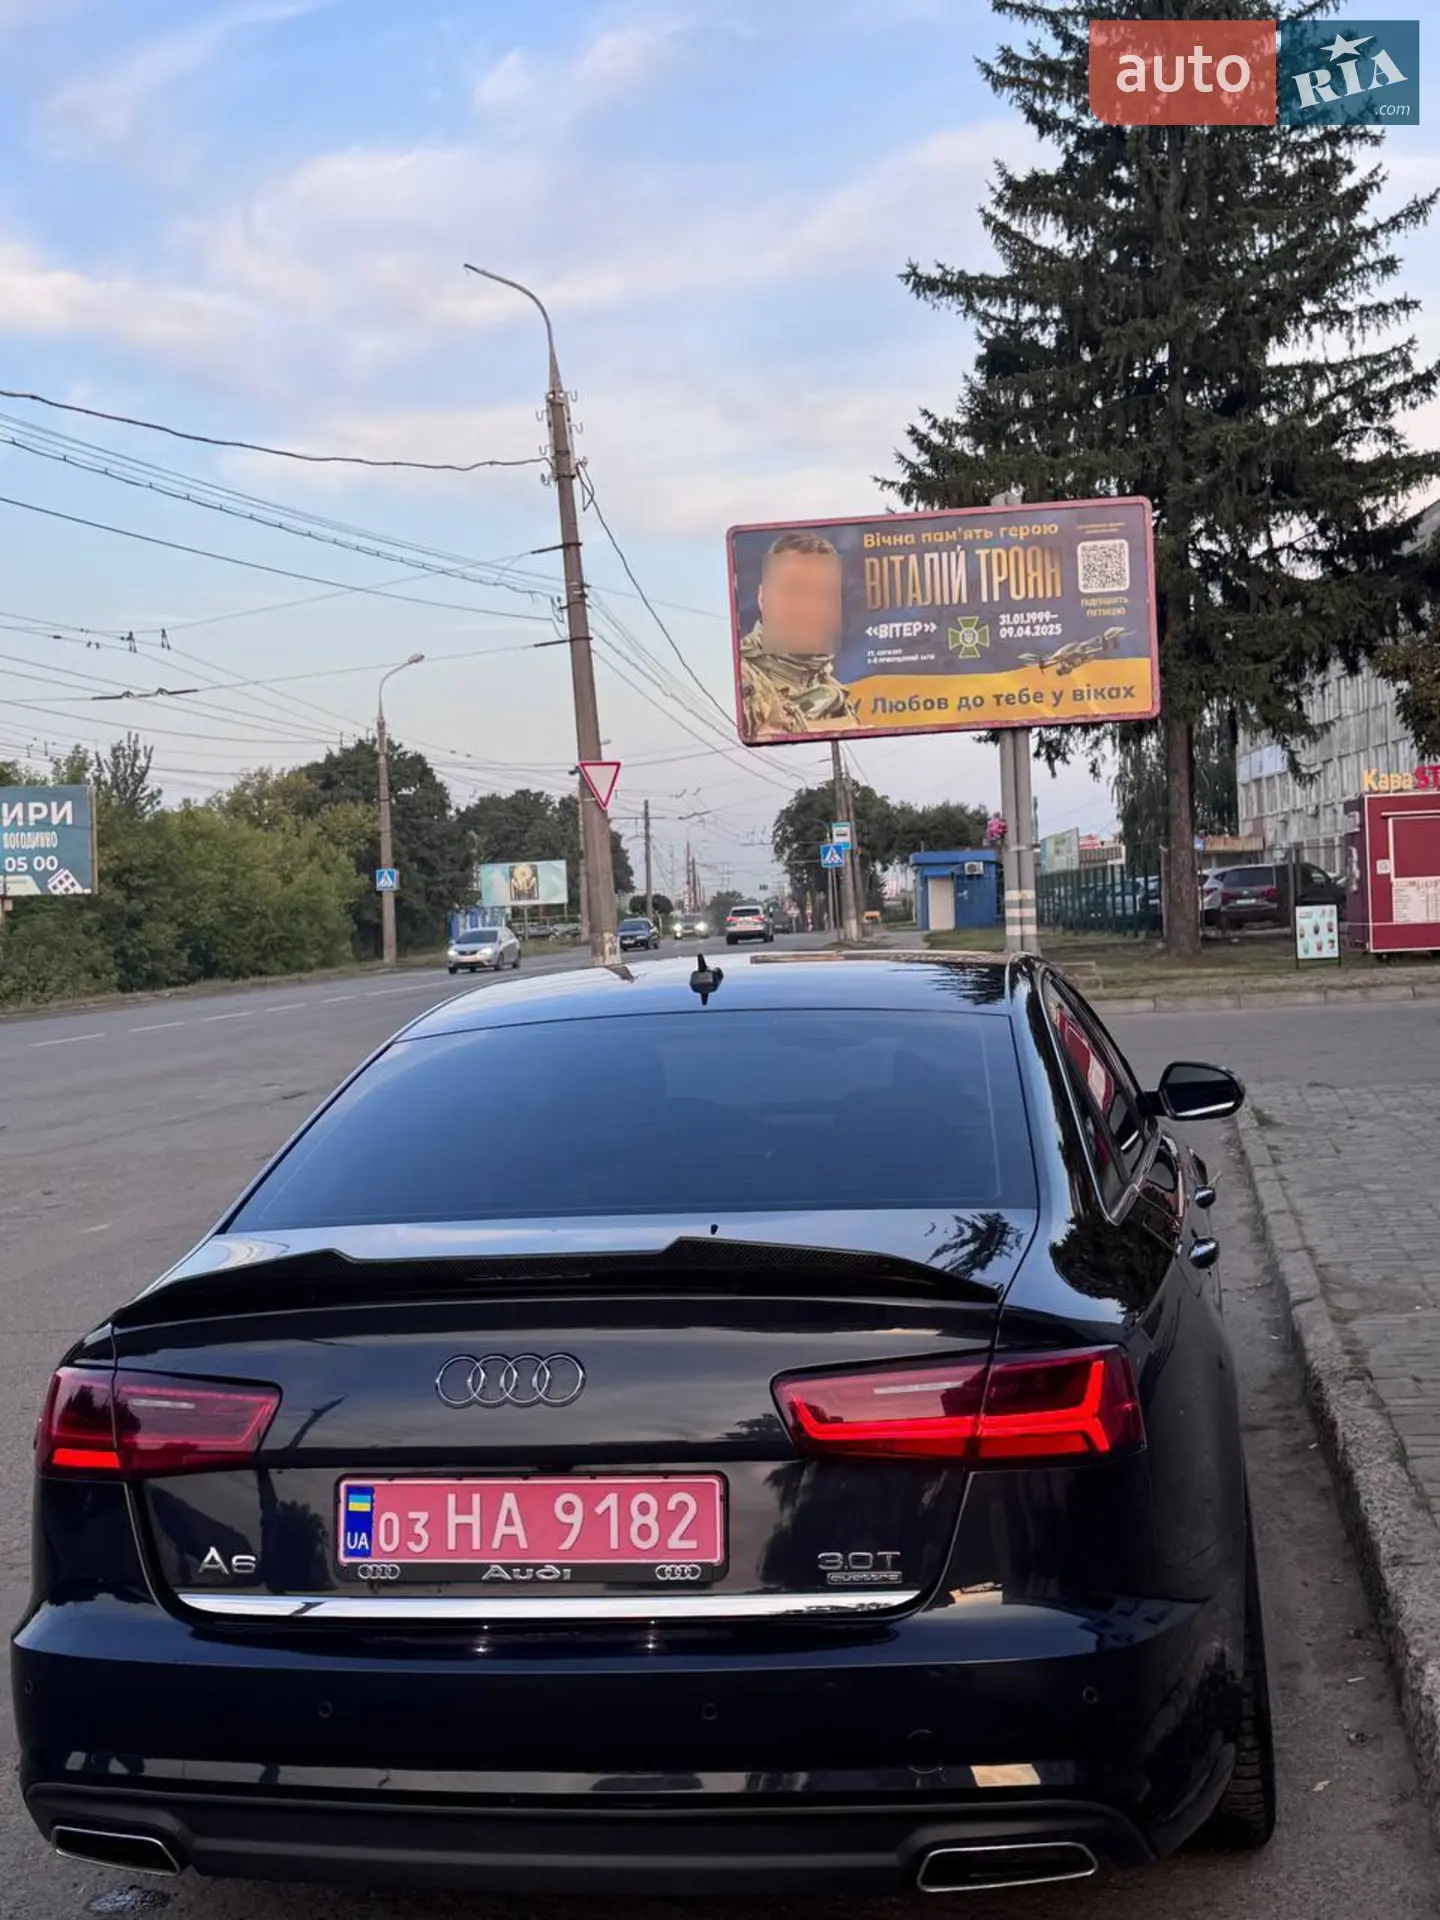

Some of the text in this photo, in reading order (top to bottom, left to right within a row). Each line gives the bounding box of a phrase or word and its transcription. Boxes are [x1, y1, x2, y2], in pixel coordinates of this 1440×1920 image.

[863, 531, 916, 549] Вічна
[999, 522, 1060, 541] герою
[864, 544, 1063, 611] ВІТАЛІЙ ТРОЯН
[865, 621, 938, 640] «ВІТЕР»
[999, 623, 1063, 639] 09.04.2025
[871, 682, 1136, 715] Любов до тебе у віках
[5, 855, 58, 872] 05 00
[378, 1492, 699, 1554] 03 HA 9182
[347, 1531, 370, 1550] UA
[198, 1545, 257, 1576] A6
[817, 1551, 901, 1571] 3.0T
[482, 1564, 572, 1582] Audi
